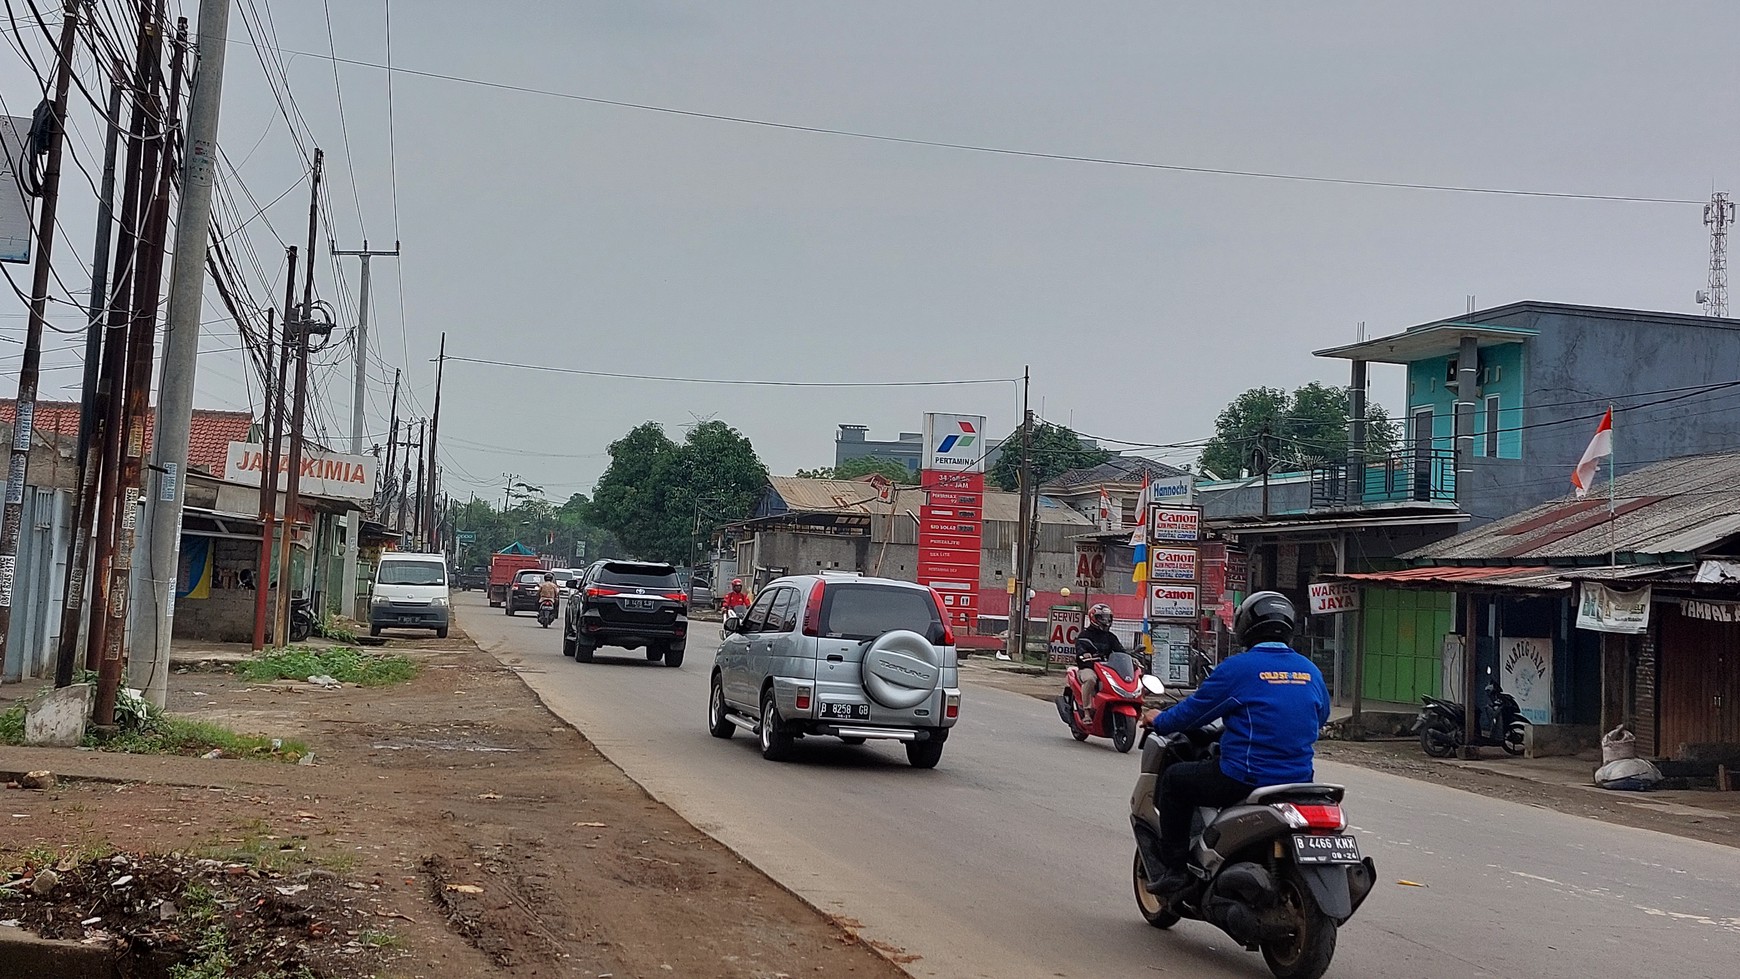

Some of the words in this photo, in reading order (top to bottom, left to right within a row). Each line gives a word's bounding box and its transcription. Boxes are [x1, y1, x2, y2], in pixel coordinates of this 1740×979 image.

[236, 451, 289, 474] JAA
[300, 458, 365, 484] KIMIA
[934, 457, 975, 466] PERTAMINA
[1154, 480, 1188, 497] Hannochs
[1158, 512, 1196, 523] Canon
[1156, 552, 1194, 562] Canon
[1076, 553, 1104, 578] AC
[1155, 589, 1194, 600] Canon
[1311, 583, 1356, 597] WARTEG
[1318, 596, 1354, 610] JAYA
[1052, 611, 1080, 622] SERVIS
[1050, 624, 1079, 644] AC
[1505, 641, 1530, 674] WARTEG
[1530, 646, 1546, 680] JAYA
[1259, 672, 1278, 680] COLD
[822, 703, 826, 712] B
[833, 704, 851, 714] 8258
[859, 705, 868, 715] GB
[1297, 838, 1304, 848] B
[1309, 838, 1332, 849] 4466
[1335, 838, 1354, 849] KNX
